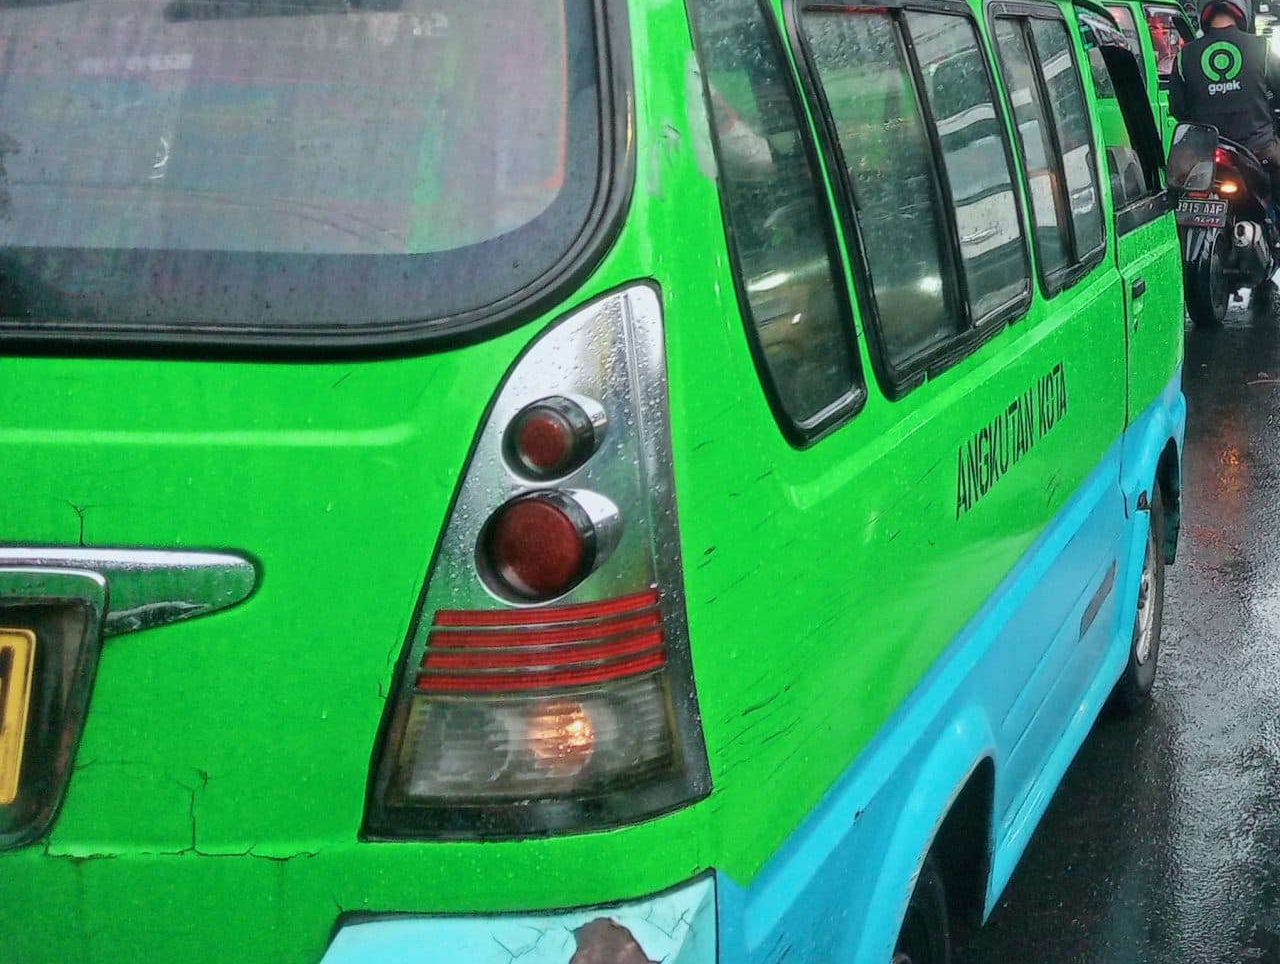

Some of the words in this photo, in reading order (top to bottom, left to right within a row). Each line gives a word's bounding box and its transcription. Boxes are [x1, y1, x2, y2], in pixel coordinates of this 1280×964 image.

[1208, 80, 1240, 95] gojek
[956, 387, 1035, 521] ANGKUTAN
[1037, 359, 1067, 440] KOTA
